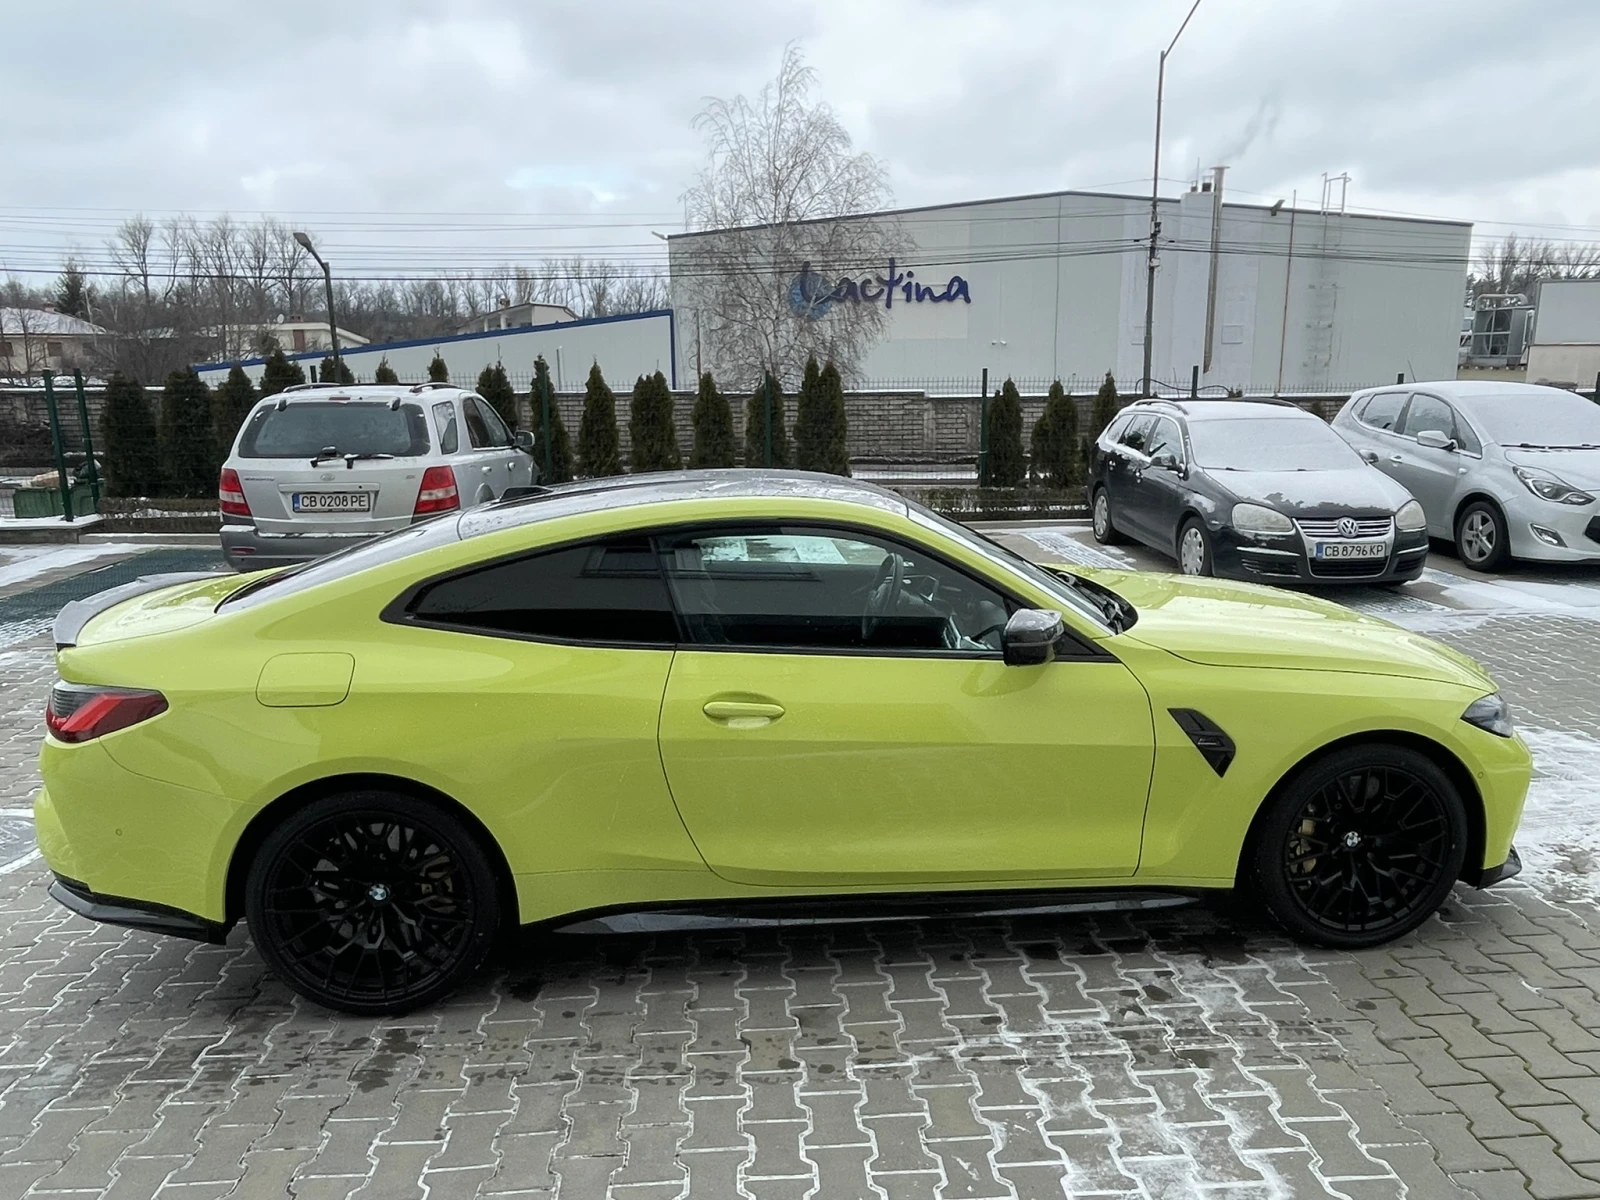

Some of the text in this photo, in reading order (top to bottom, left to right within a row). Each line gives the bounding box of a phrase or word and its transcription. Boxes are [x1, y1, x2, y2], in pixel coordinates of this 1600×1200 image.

[301, 495, 366, 507] CB 0208 PE
[1324, 544, 1384, 557] CB 8796 KP
